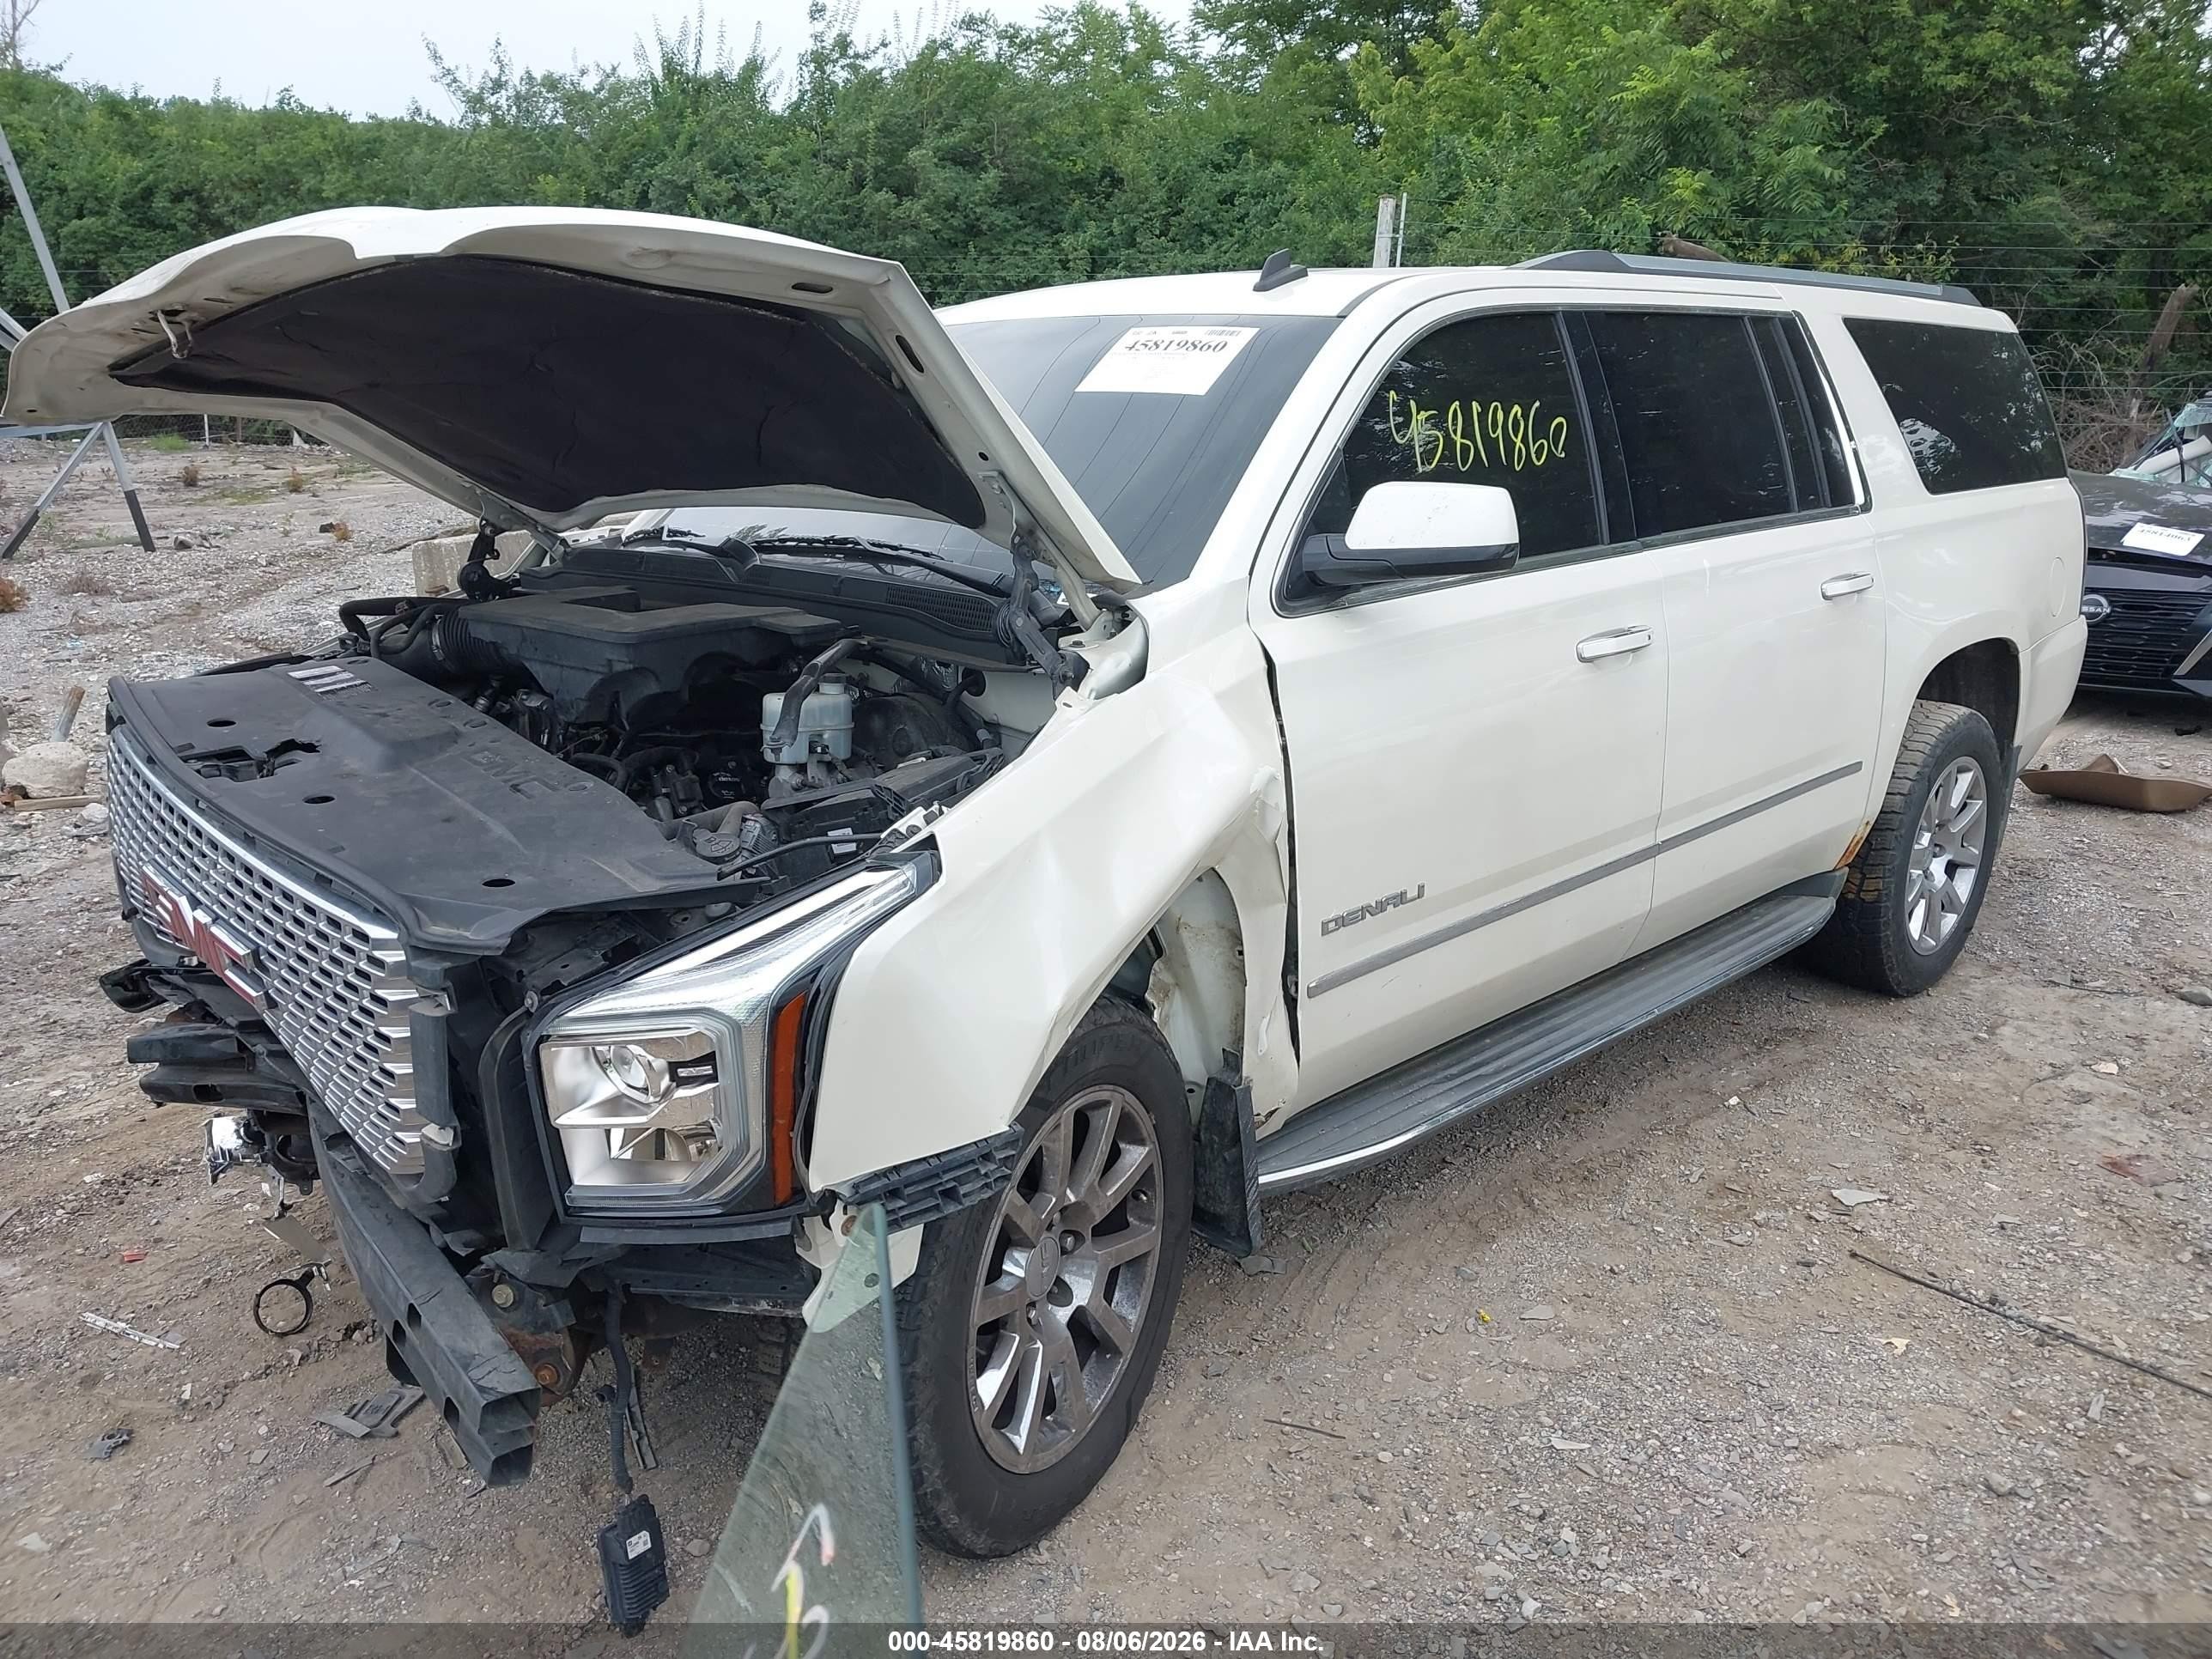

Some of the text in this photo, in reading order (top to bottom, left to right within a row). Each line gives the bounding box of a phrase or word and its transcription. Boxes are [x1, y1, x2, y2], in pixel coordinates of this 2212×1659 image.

[1124, 339, 1228, 353] 45819860
[1389, 390, 1567, 473] 45819860
[2081, 605, 2112, 614] SSAN
[1321, 883, 1425, 937] DENALI
